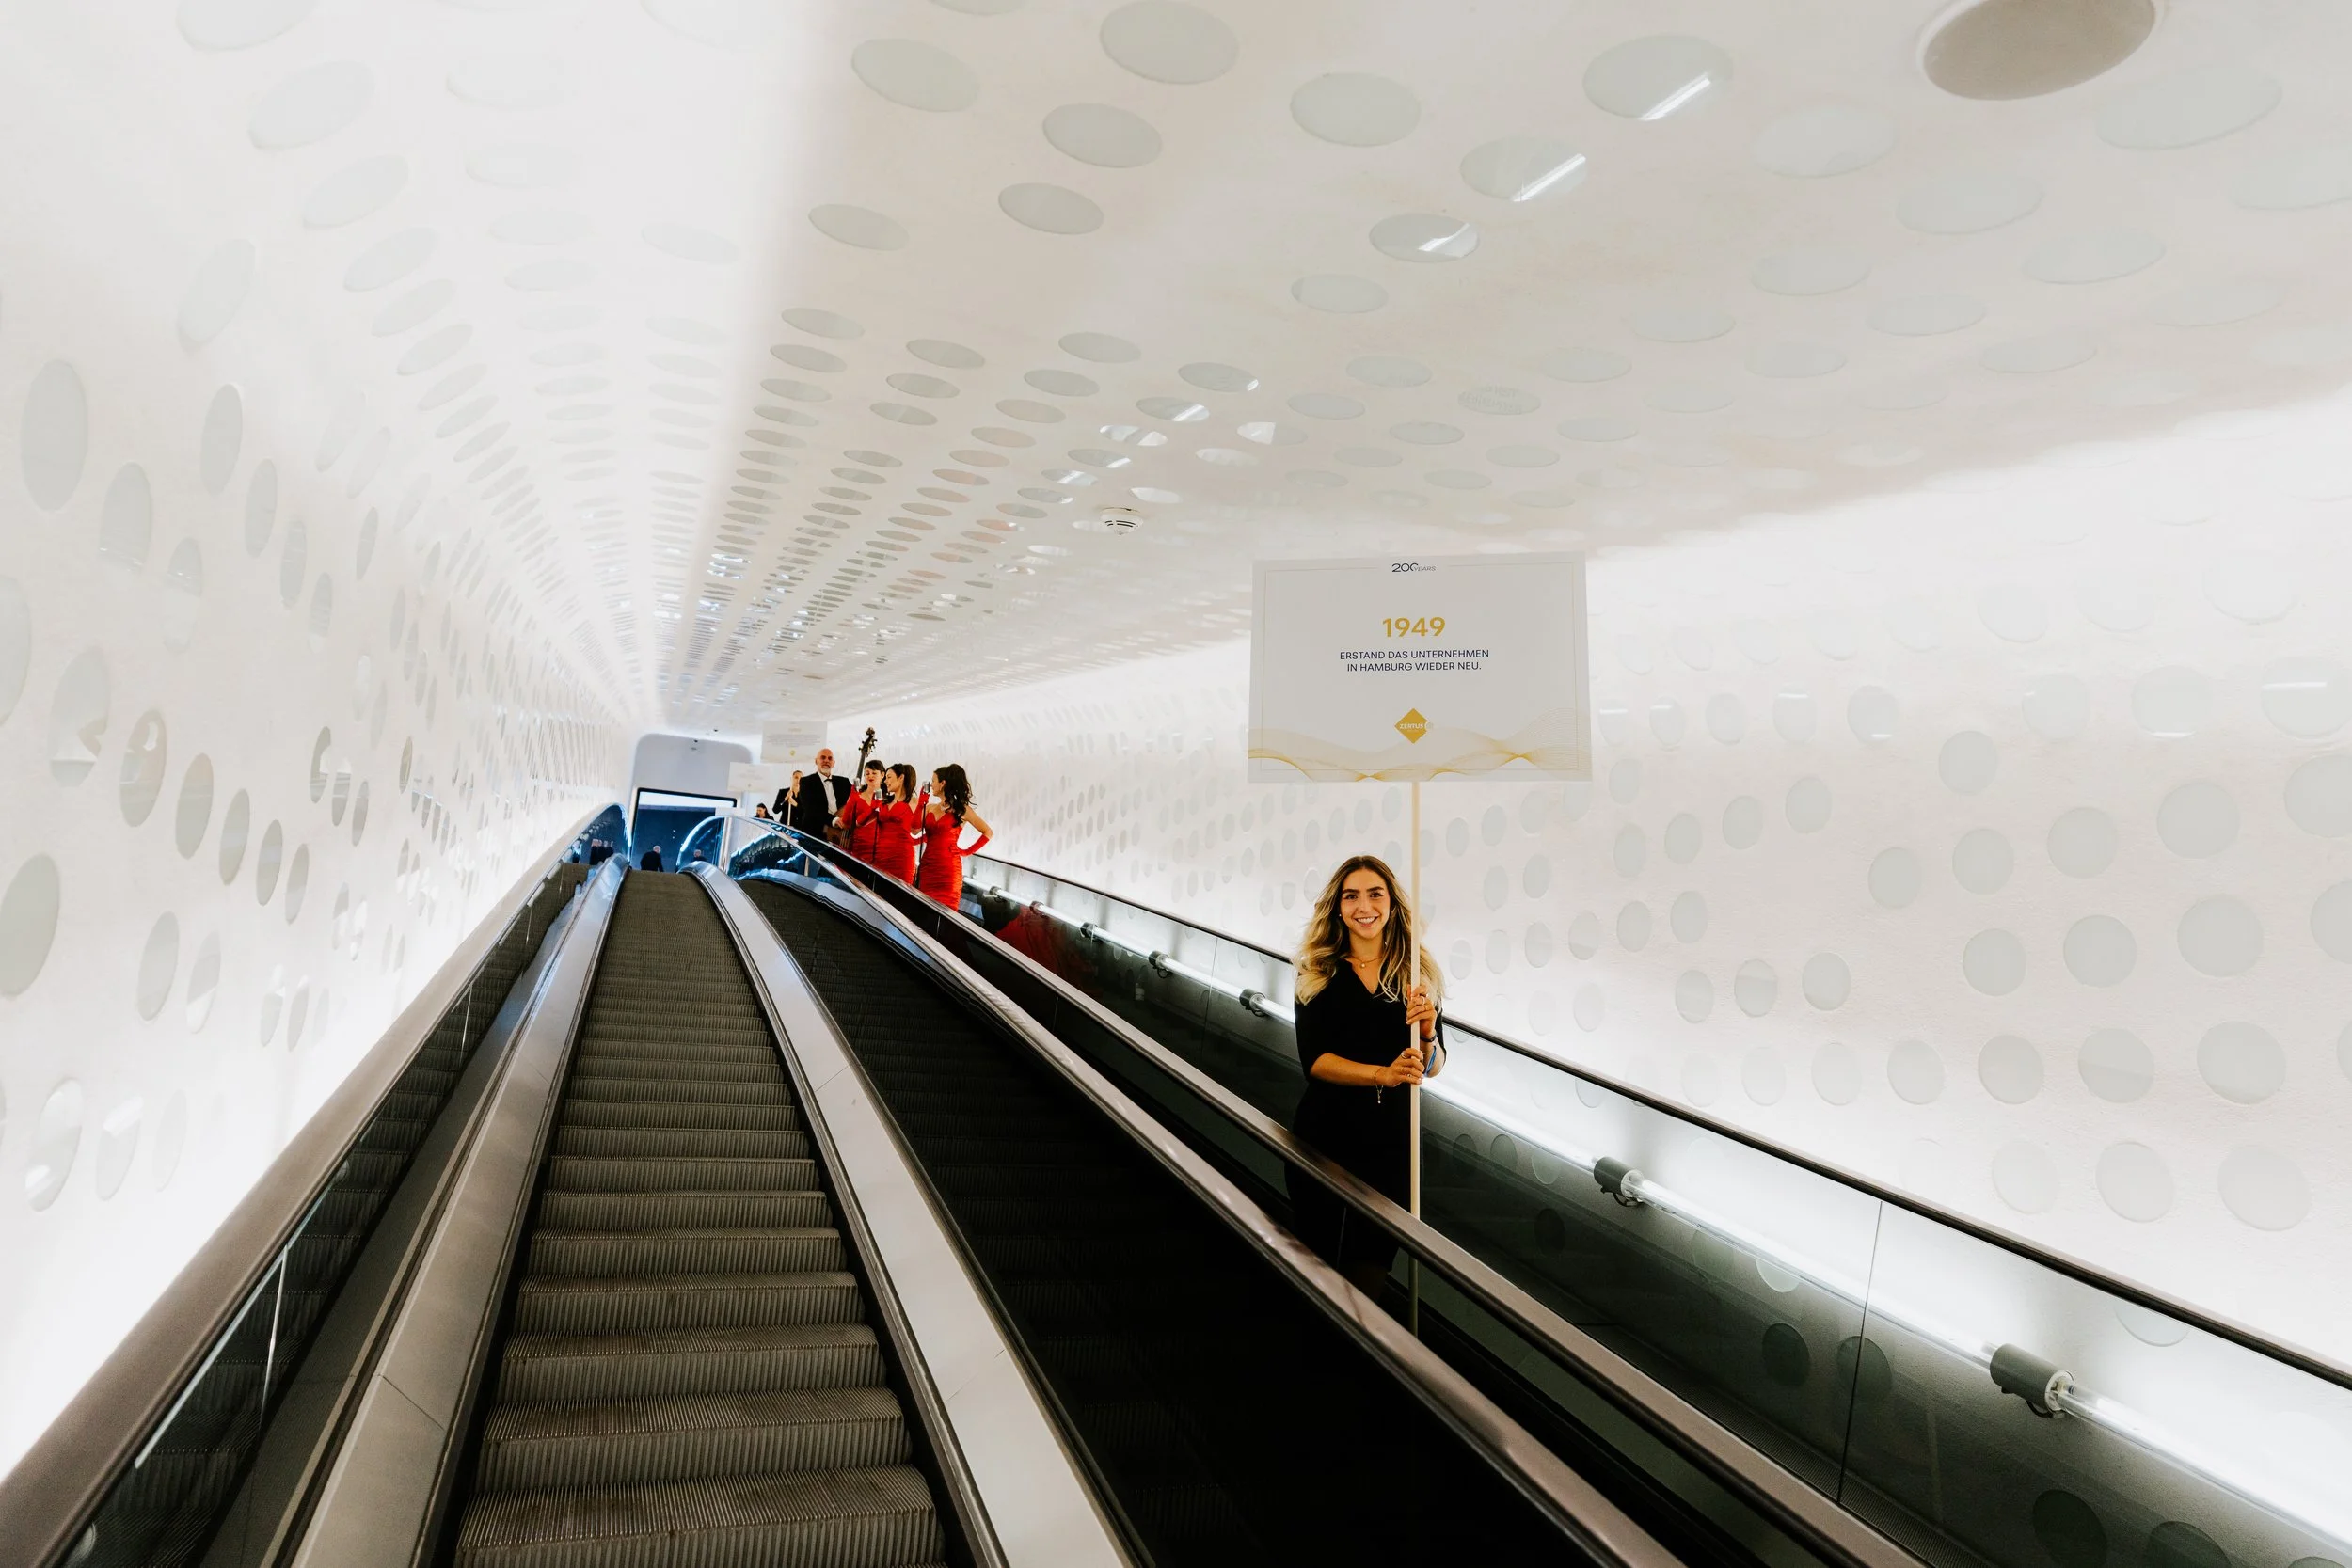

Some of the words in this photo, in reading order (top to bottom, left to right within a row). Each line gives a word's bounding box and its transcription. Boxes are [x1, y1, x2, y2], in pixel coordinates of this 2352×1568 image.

[1382, 616, 1446, 637] 1949
[1340, 651, 1385, 659] ERSTAND
[1388, 650, 1408, 659] DAS
[1410, 649, 1489, 658] UNTERNEHMEN
[1347, 663, 1358, 672] IN
[1359, 662, 1412, 672] HAMBURG
[1415, 661, 1455, 671] WIEDER
[1457, 661, 1482, 671] NEU.
